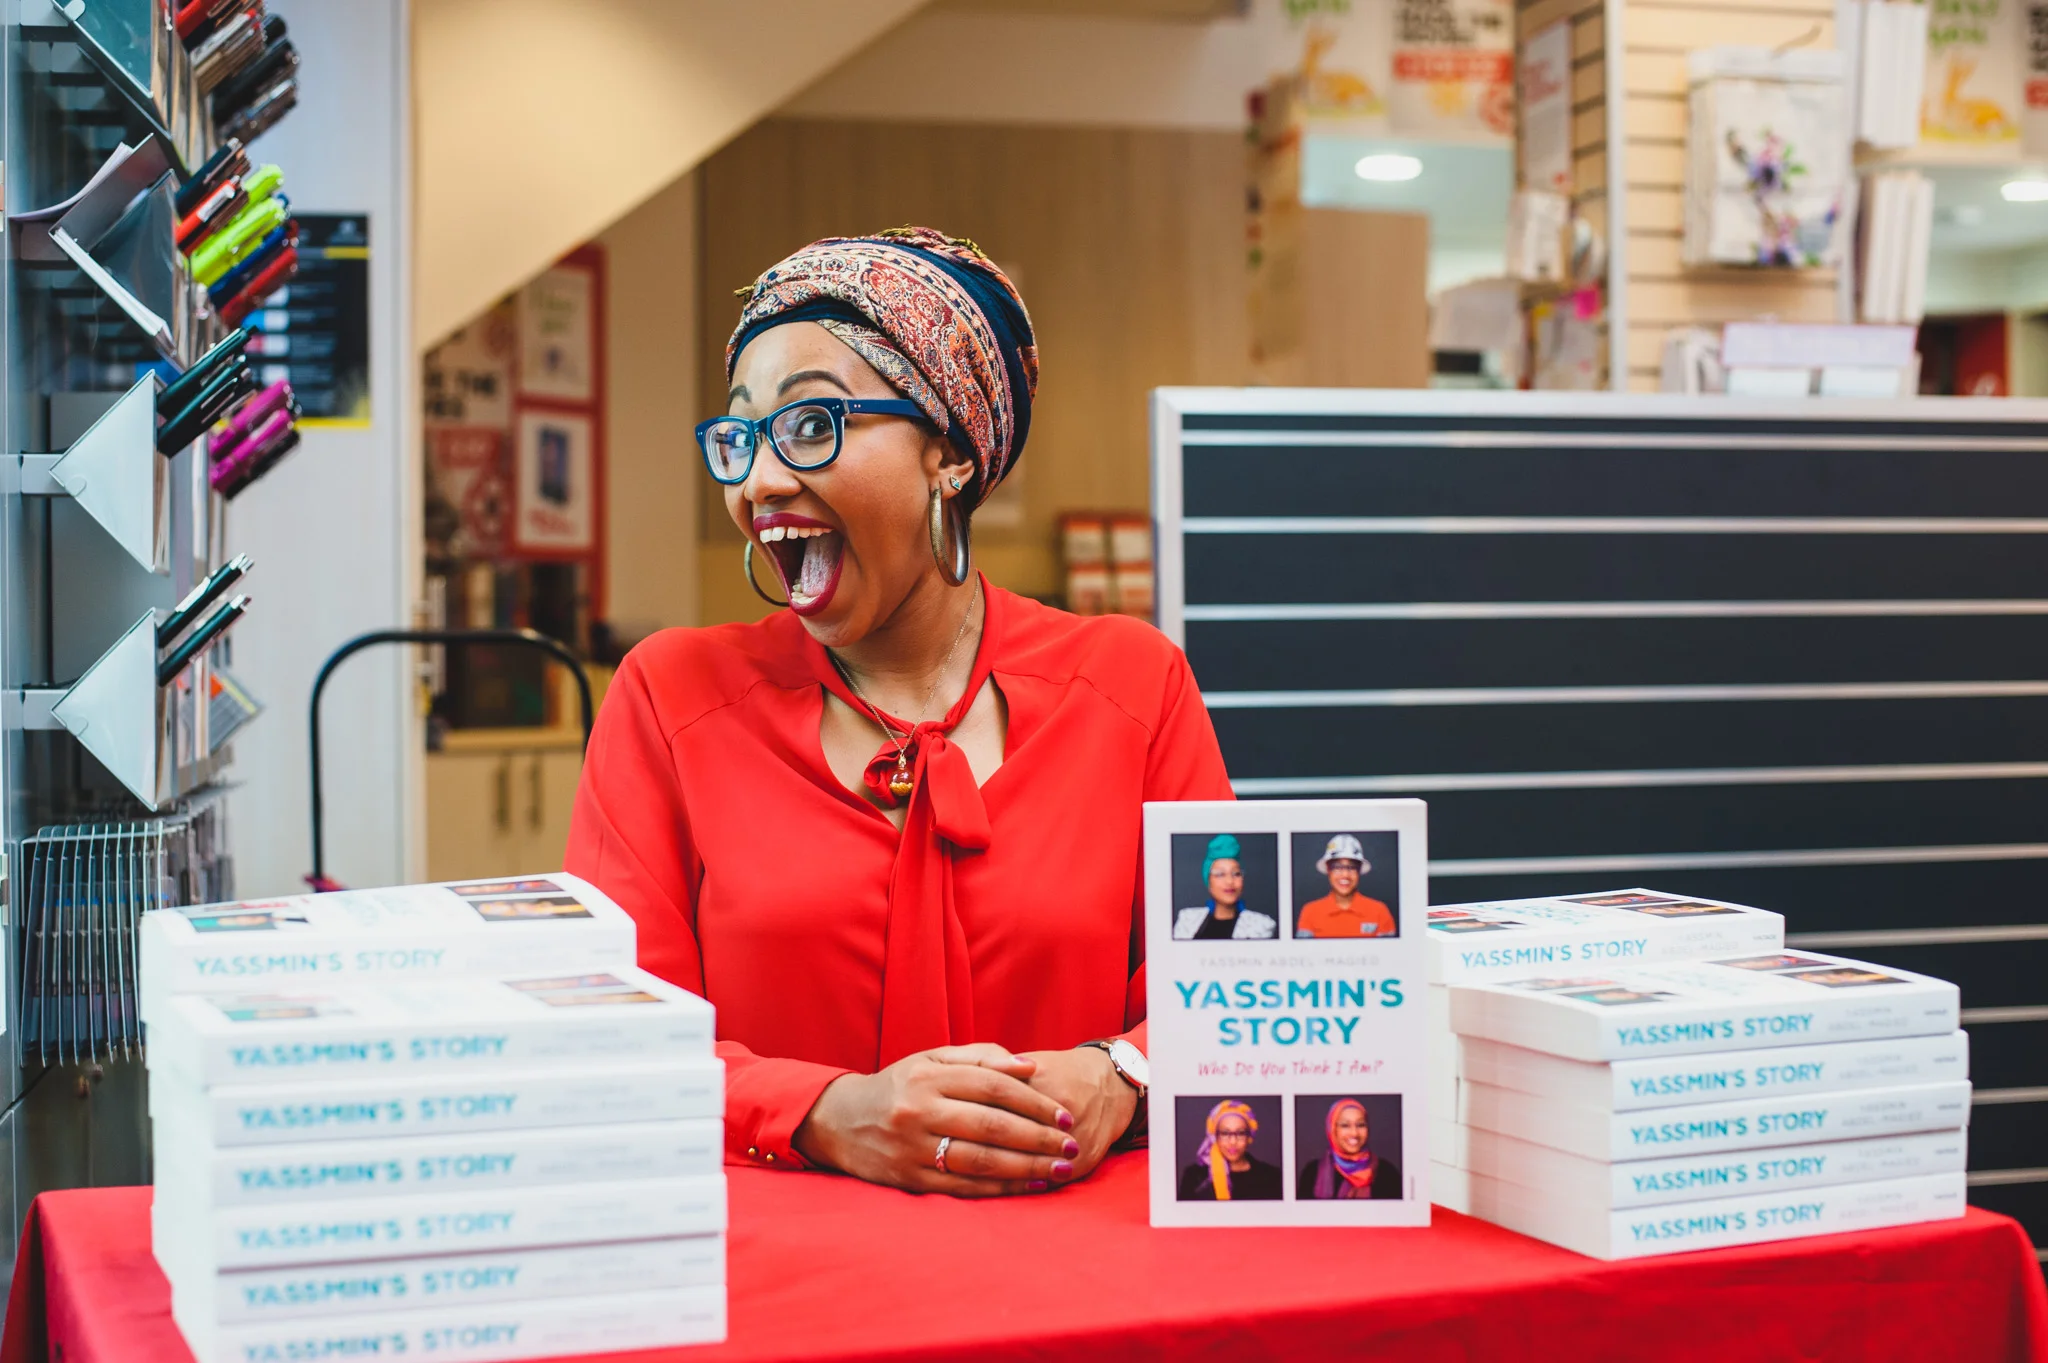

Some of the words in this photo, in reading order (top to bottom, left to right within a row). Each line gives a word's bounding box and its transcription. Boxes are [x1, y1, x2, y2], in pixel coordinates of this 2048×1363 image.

[194, 953, 342, 975] YASSMIN'S
[355, 948, 444, 971] STORY
[1462, 945, 1572, 966] YASSMIN'S
[1581, 939, 1647, 960] STORY
[1176, 979, 1403, 1009] YASSMIN'S
[1219, 1017, 1359, 1045] STORY
[1618, 1020, 1734, 1044] YASSMIN'S
[1744, 1015, 1811, 1036] STORY
[232, 1041, 395, 1065] YASSMIN'S
[411, 1036, 507, 1060] STORY
[1197, 1062, 1228, 1076] Who
[1234, 1062, 1254, 1076] Do
[1260, 1062, 1286, 1079] You
[1292, 1061, 1330, 1075] Think
[1335, 1060, 1344, 1075] I
[1350, 1060, 1384, 1076] Am?
[1631, 1069, 1746, 1096] YASSMIN'S
[1756, 1064, 1823, 1086] STORY
[240, 1101, 404, 1127] YASSMIN'S
[419, 1095, 515, 1120] STORY
[1632, 1118, 1748, 1142] YASSMIN'S
[1758, 1111, 1826, 1134] STORY
[240, 1161, 402, 1188] YASSMIN'S
[418, 1155, 514, 1180] STORY
[1634, 1165, 1748, 1191] YASSMIN'S
[1758, 1157, 1824, 1180] STORY
[240, 1220, 402, 1248] YASSMIN'S
[416, 1213, 513, 1239] STORY
[1632, 1212, 1746, 1239] YASSMIN'S
[1756, 1204, 1824, 1228] STORY
[245, 1275, 407, 1304] YASSMIN'S
[422, 1267, 518, 1293] STORY
